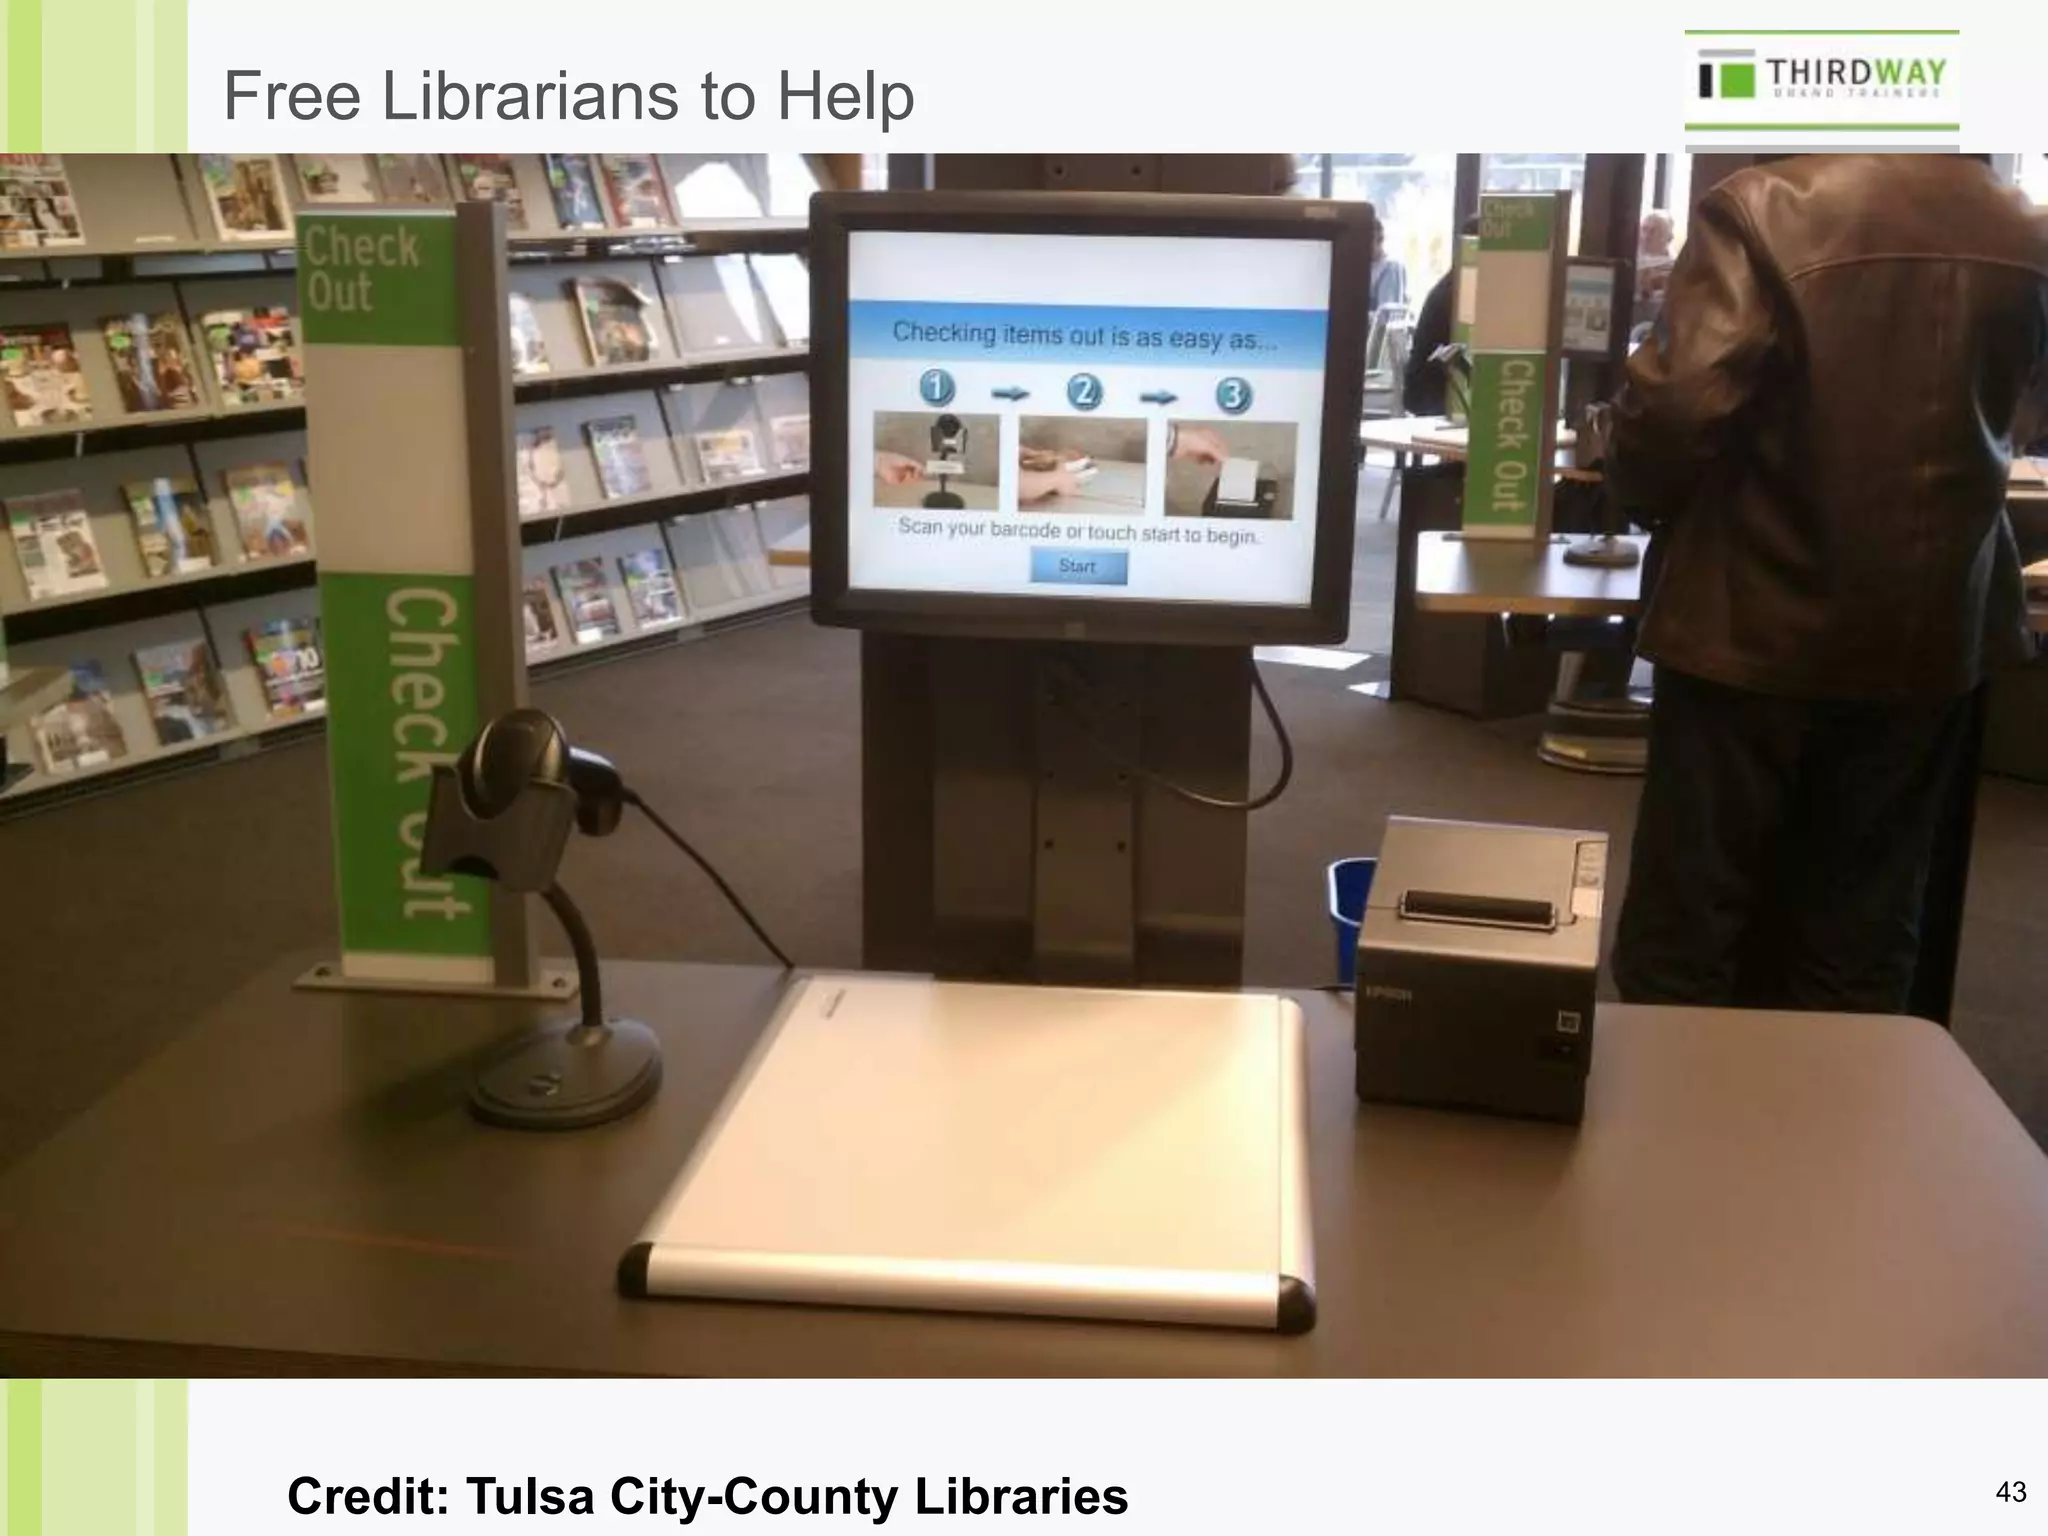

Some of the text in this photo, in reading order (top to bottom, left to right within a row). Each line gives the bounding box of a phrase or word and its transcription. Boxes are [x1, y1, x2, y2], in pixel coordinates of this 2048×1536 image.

[305, 223, 420, 268] Check
[308, 269, 374, 312] Out
[893, 318, 1278, 355] Checking items out is as easy as...
[1492, 359, 1536, 512] Check Out
[899, 516, 1262, 549] Scan your barcode or touch start to begin.
[1059, 558, 1096, 574] Start
[386, 588, 461, 783] Check
